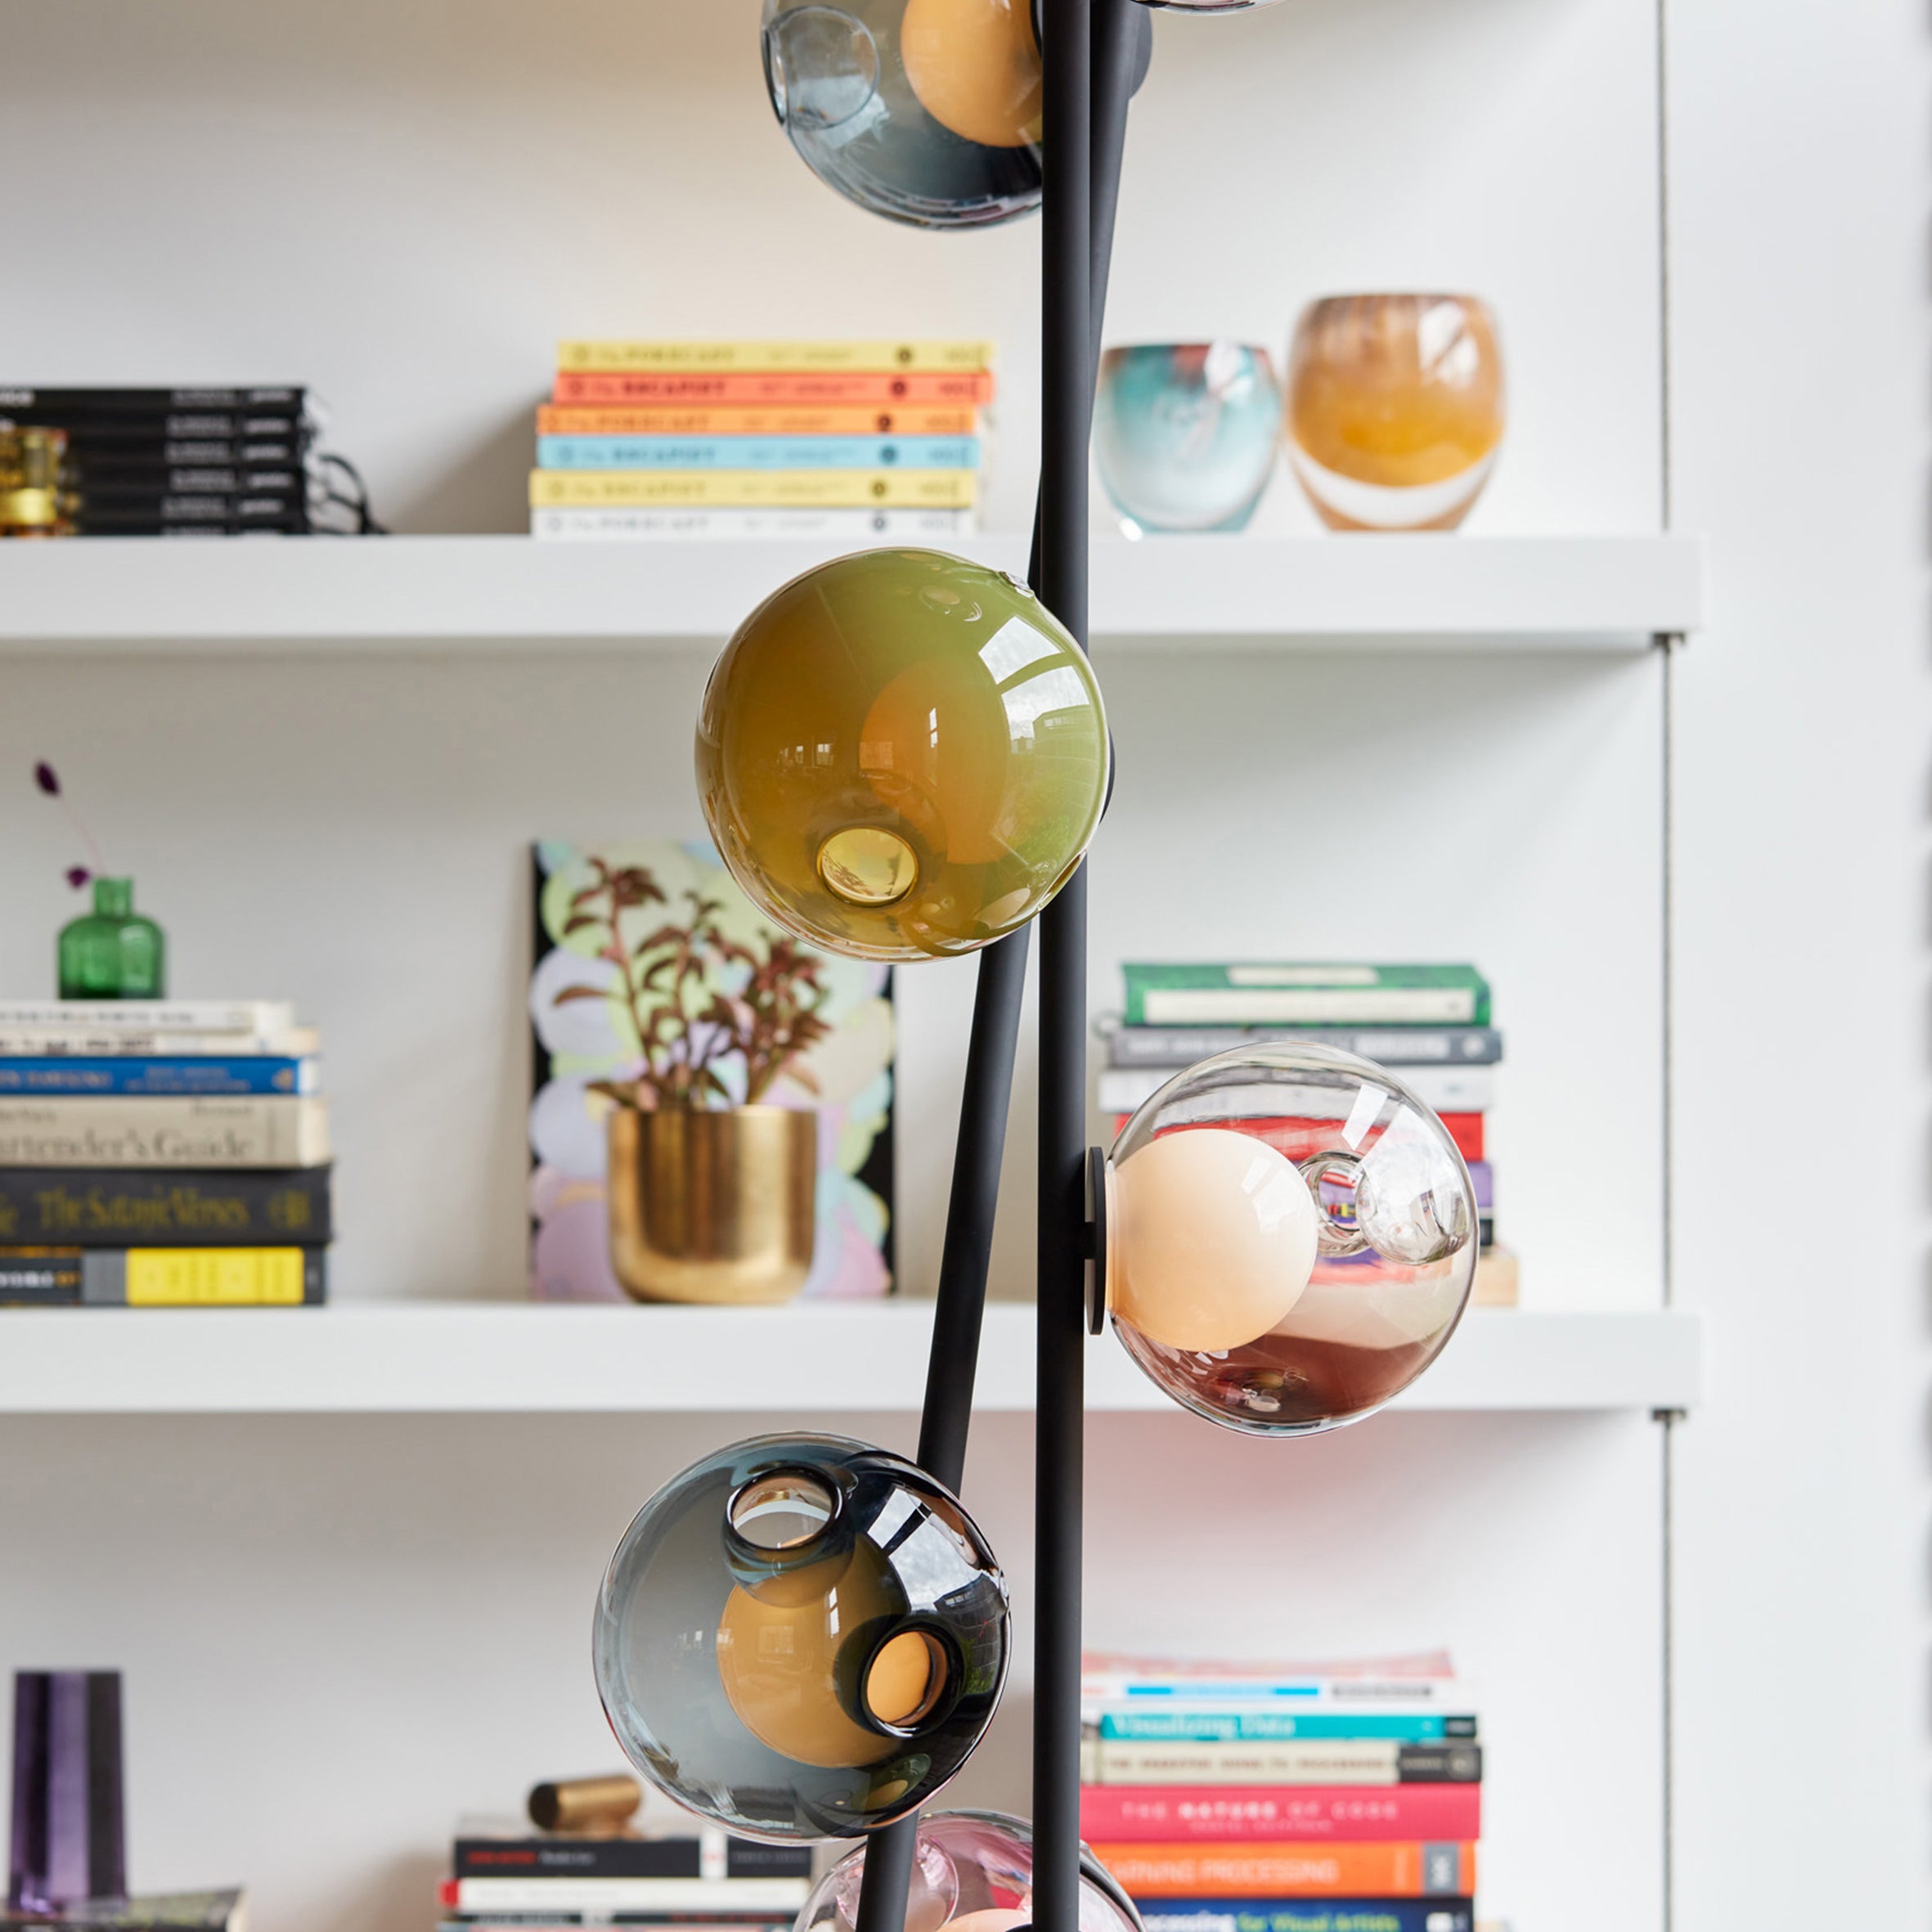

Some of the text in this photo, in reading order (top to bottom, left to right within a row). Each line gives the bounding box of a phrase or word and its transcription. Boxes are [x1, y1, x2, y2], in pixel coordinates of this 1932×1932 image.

[153, 1127, 254, 1158] Guide
[35, 1185, 82, 1229] The
[1108, 1714, 1297, 1741] Visualizing Data
[1121, 1800, 1398, 1822] THE NATURE OF CODE
[1103, 1858, 1341, 1885] ARNING PROCESSING
